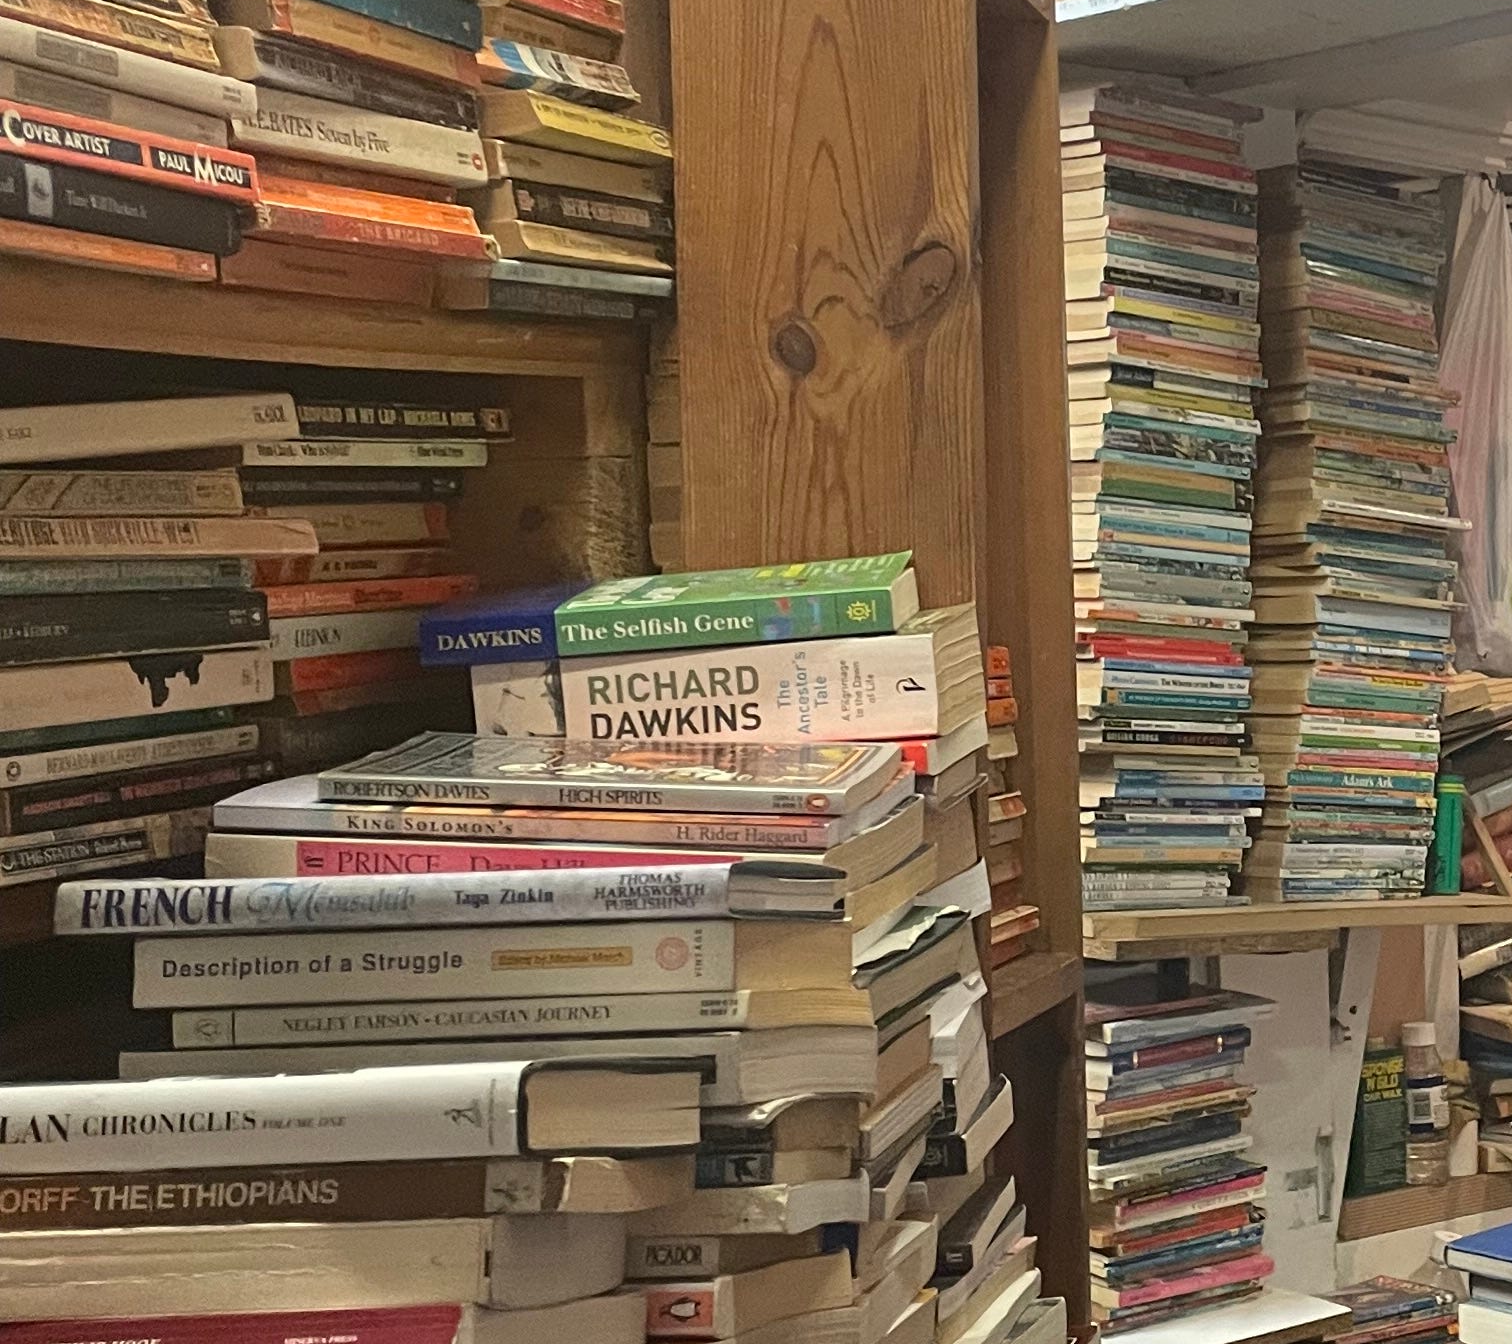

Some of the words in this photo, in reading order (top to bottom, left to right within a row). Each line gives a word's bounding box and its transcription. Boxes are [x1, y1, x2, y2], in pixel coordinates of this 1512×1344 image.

[2, 109, 62, 148] COVER
[65, 129, 111, 156] ARTIST
[158, 149, 191, 174] PAUL
[194, 150, 243, 187] MICOU
[437, 627, 542, 651] DAWKINS
[561, 621, 608, 644] The
[613, 616, 688, 640] Selfish
[694, 610, 754, 633] Gene
[588, 664, 760, 705] RICHARD
[590, 702, 762, 739] DAWKINS
[433, 784, 490, 802] DAVIES
[559, 787, 599, 805] HIGH
[604, 788, 663, 806] SPIRITS
[347, 815, 395, 831] KING
[80, 885, 235, 927] FRENCH
[162, 956, 300, 980] Description
[339, 956, 352, 972] a
[361, 949, 463, 977] Struggle
[81, 1109, 257, 1137] CHRONICLES
[91, 1185, 150, 1213] THE
[155, 1178, 339, 1208] ETHIOPIANS
